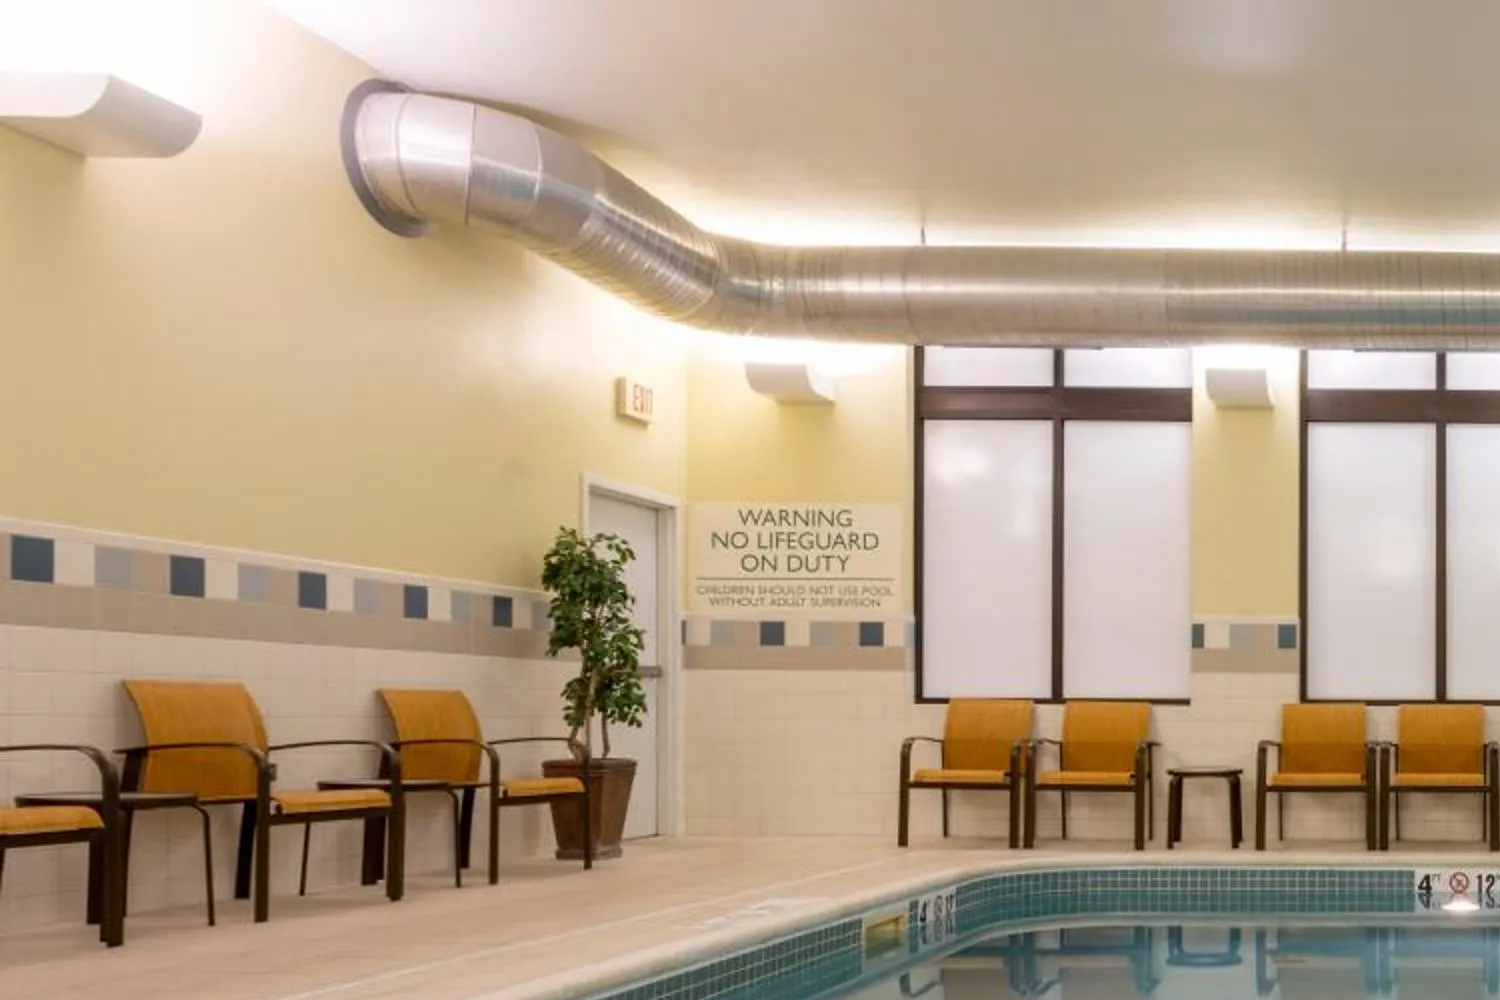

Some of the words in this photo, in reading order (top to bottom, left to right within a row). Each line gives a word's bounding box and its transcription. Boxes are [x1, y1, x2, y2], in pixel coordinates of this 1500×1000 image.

[737, 509, 853, 527] WARNING
[711, 531, 749, 550] NO
[757, 531, 879, 550] LIFEGUARD
[740, 554, 778, 573] ON
[787, 554, 850, 573] DUTY
[696, 585, 754, 596] CHILDREN
[758, 585, 805, 596] SHOULD
[810, 585, 834, 596] NOT
[839, 585, 858, 596] USE
[862, 585, 894, 597] POOL
[709, 597, 765, 608] WITHOUT
[770, 597, 805, 608] ADULT
[811, 597, 881, 609] SUPERVISION
[1418, 873, 1432, 892] 4
